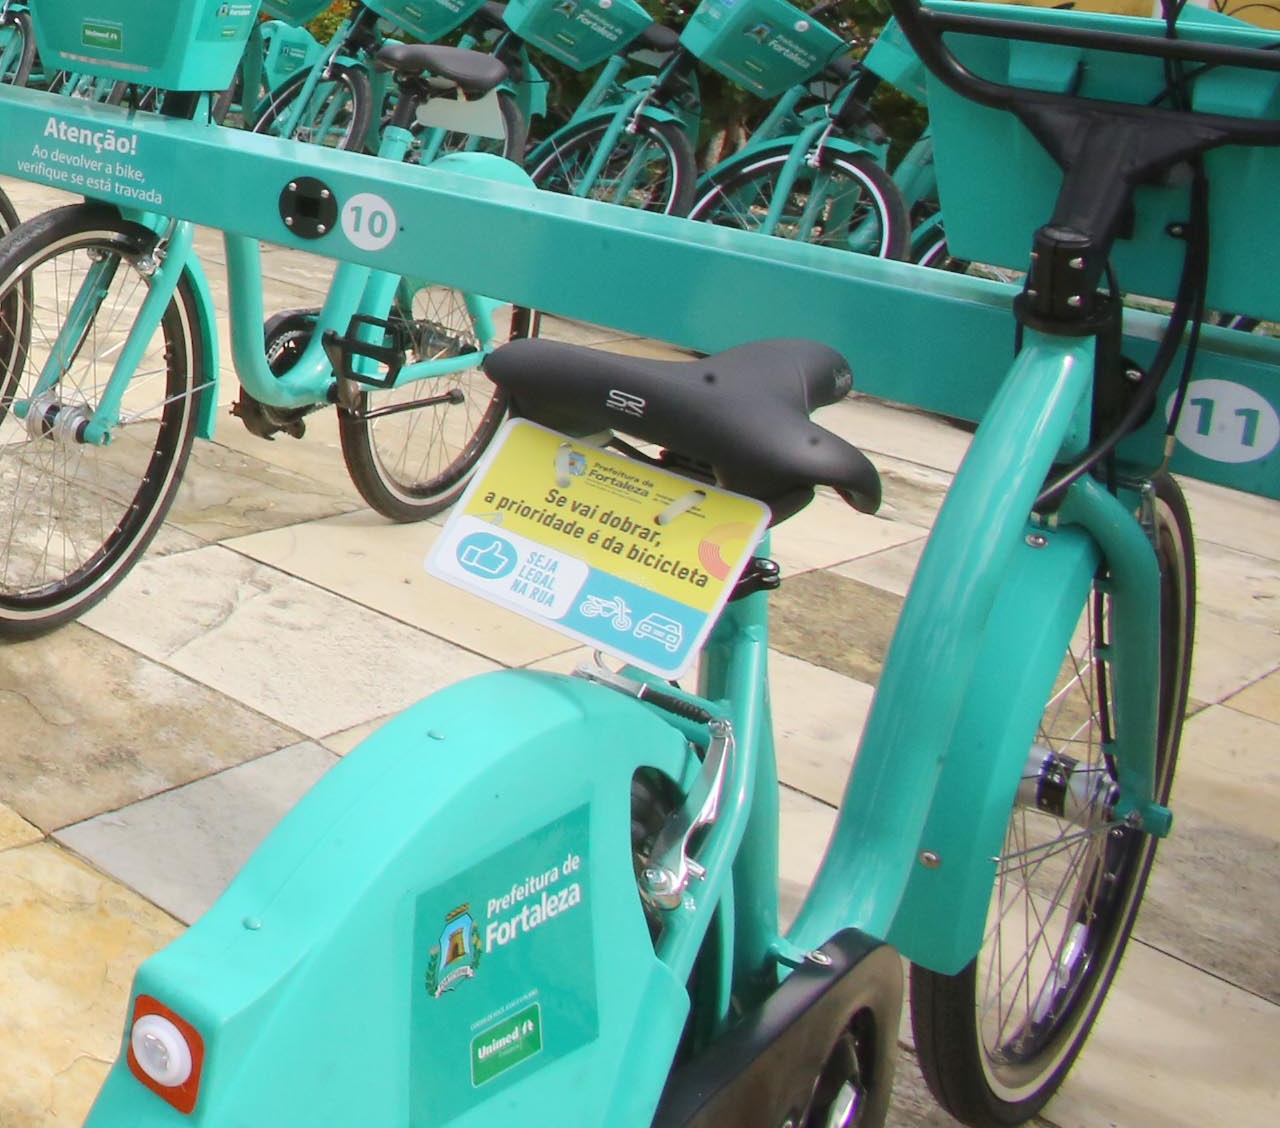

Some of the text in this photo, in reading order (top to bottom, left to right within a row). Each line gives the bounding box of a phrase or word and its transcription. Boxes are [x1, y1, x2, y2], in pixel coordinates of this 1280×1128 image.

[576, 13, 618, 42] Fortaleza
[768, 39, 811, 69] Fortaleza
[44, 116, 138, 155] Atenção!
[31, 144, 146, 184] Ao devolver a bike,
[17, 159, 163, 205] verifique se está travada
[350, 205, 388, 239] 10
[1189, 397, 1262, 447] 11
[588, 469, 649, 498] Fortaleza
[593, 462, 641, 484] Prefeitura
[545, 488, 568, 508] Se
[570, 498, 598, 520] vai
[599, 509, 662, 547] dobrar,
[484, 491, 710, 589] a prioridade é da bicicleta
[518, 565, 556, 591] LEGAL
[526, 550, 560, 573] SEJA
[510, 578, 556, 608] NA RUA
[487, 852, 581, 919] Prefeitura de
[485, 882, 582, 953] Fortaleza
[478, 1025, 520, 1059] Unimed
